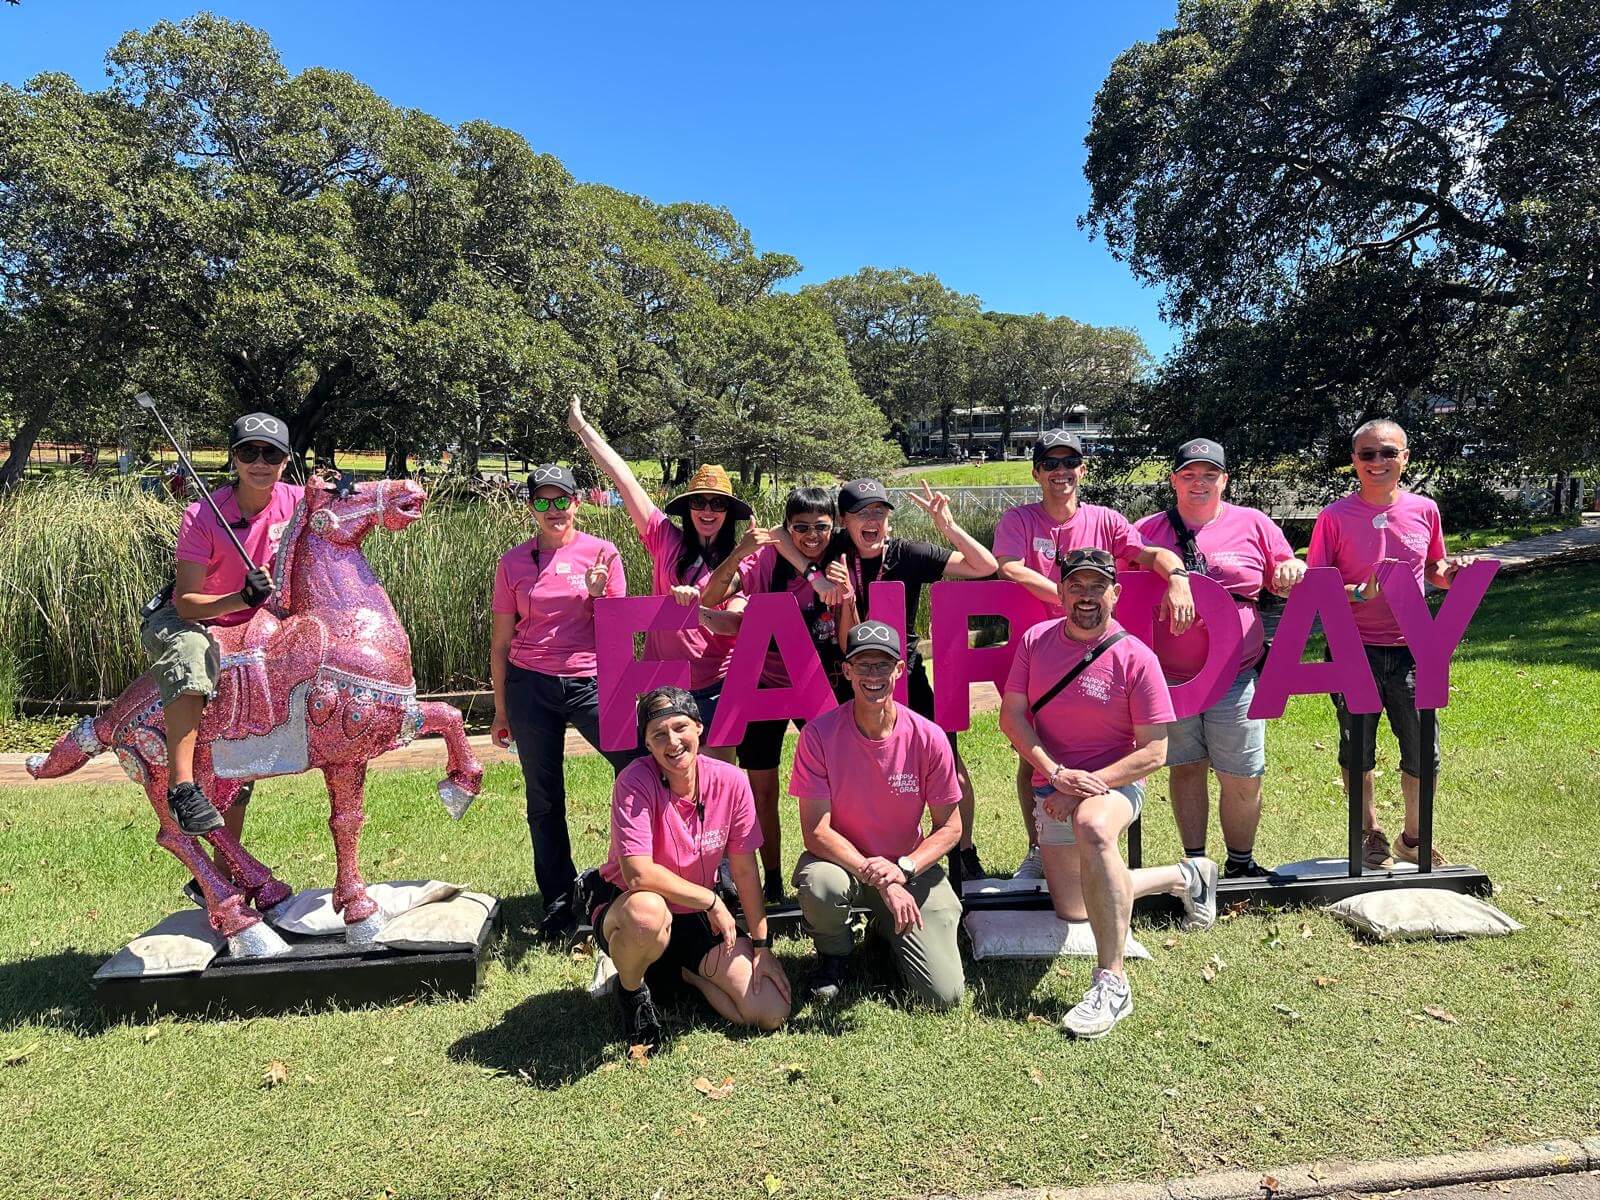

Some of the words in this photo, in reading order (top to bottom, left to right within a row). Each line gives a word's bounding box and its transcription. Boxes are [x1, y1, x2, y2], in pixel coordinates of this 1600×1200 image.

[1113, 558, 1501, 721] DAY
[1079, 675, 1106, 687] HAPPY
[1080, 681, 1106, 693] MARDI
[888, 773, 914, 781] HAPPY
[891, 780, 917, 788] MARDI
[899, 786, 920, 794] GRAS
